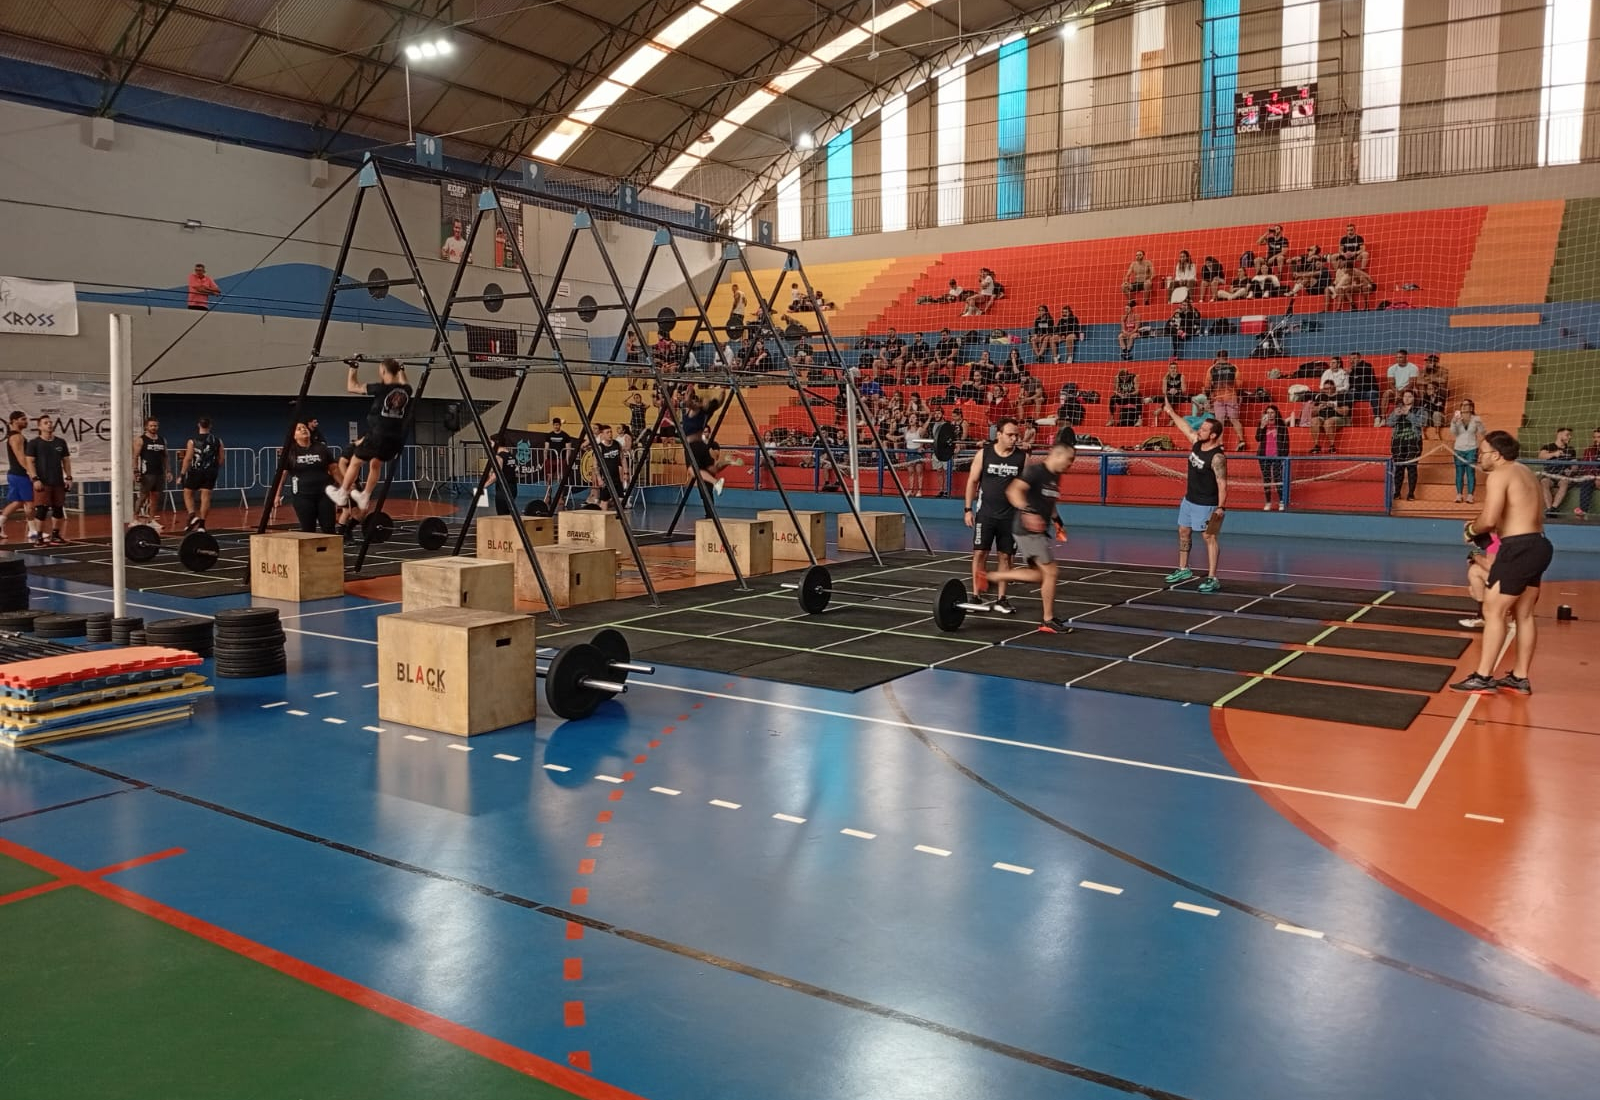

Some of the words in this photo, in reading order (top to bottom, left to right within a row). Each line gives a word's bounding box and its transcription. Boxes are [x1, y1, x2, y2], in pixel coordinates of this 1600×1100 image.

[1237, 124, 1261, 133] LOCAL
[423, 138, 436, 156] 10
[529, 163, 538, 179] 9
[447, 183, 467, 194] EDER
[625, 187, 632, 204] 8
[699, 206, 706, 220] 7
[762, 222, 769, 236] 6
[2, 311, 56, 328] CROSS
[567, 530, 591, 539] BRAVUS
[487, 539, 514, 553] BLACK
[708, 543, 738, 554] BLAK
[261, 561, 288, 576] BLACK
[397, 662, 446, 691] BLACK
